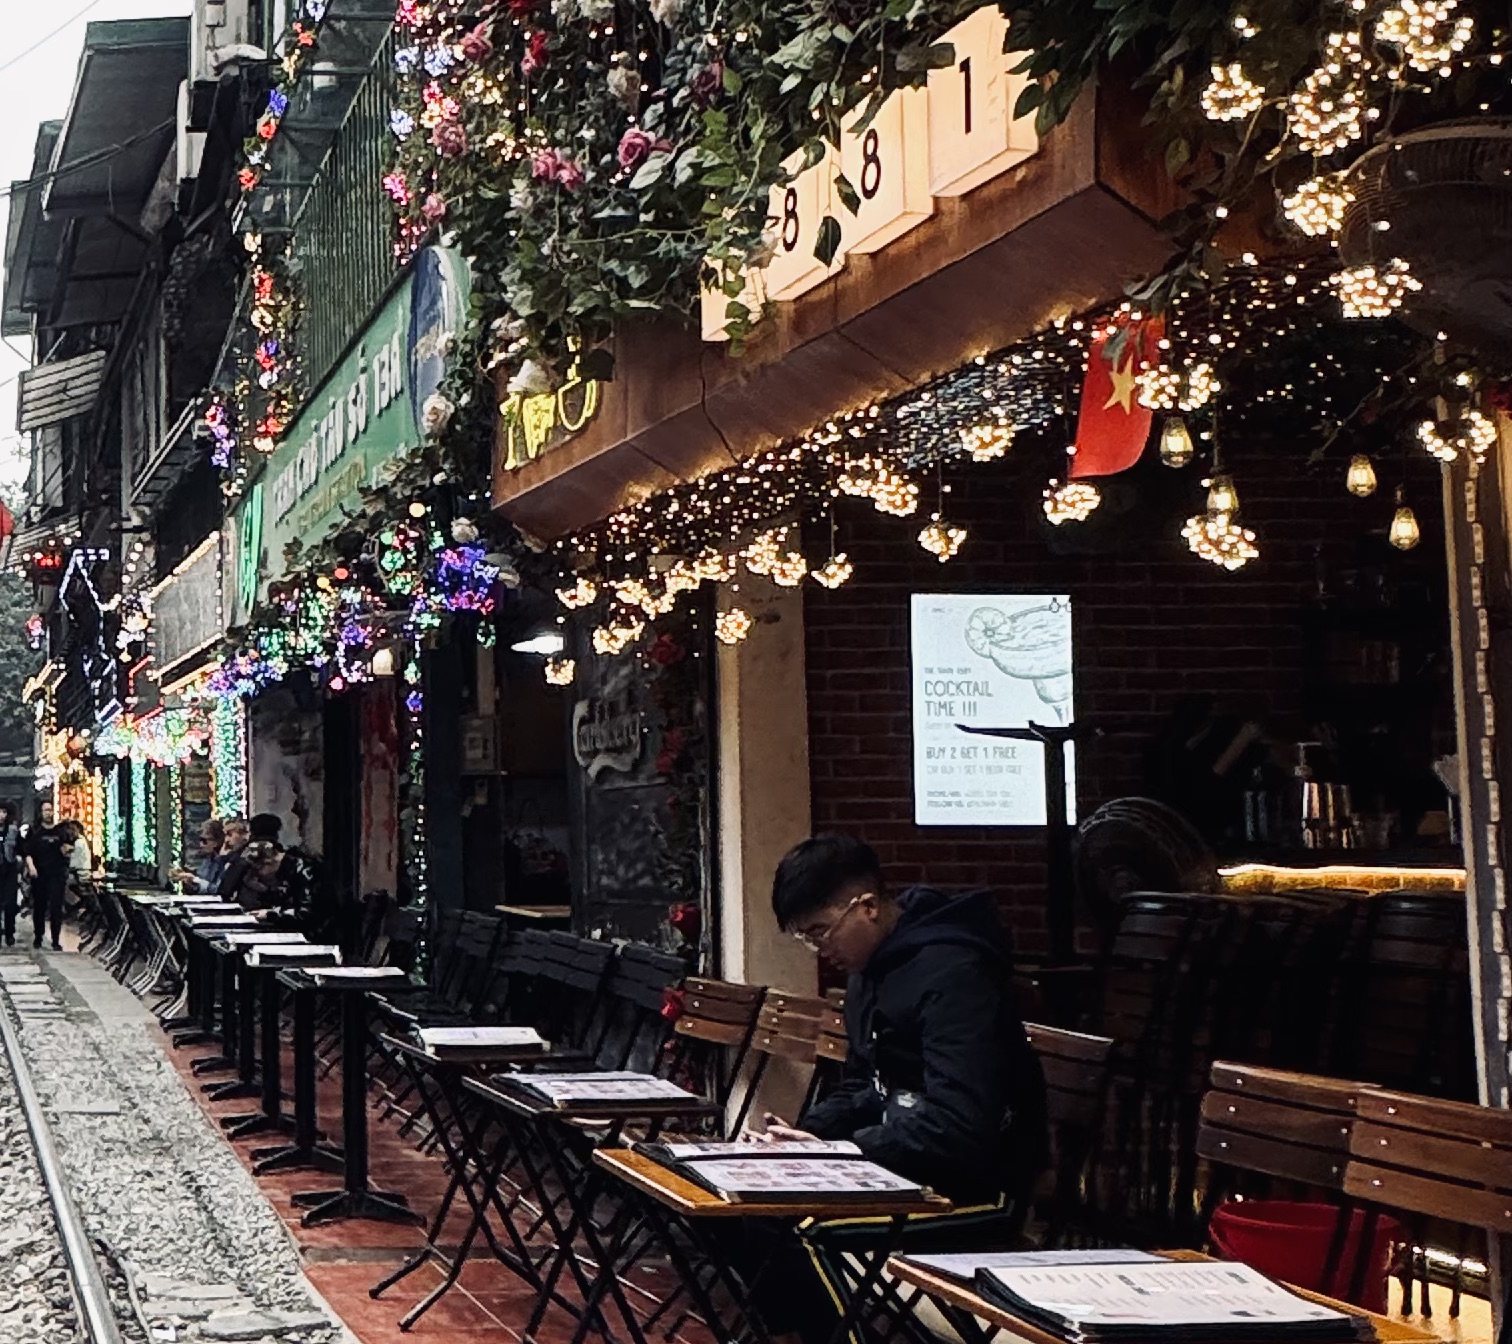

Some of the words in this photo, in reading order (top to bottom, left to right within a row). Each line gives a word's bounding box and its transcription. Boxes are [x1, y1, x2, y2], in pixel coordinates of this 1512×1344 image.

[346, 343, 368, 444] SỐ
[372, 332, 403, 416] 13A
[924, 680, 993, 697] COCKTAIL
[925, 700, 955, 716] TIME
[926, 746, 946, 759] BUY
[950, 746, 957, 759] 2
[960, 746, 979, 759] GET
[992, 746, 1017, 759] FREE
